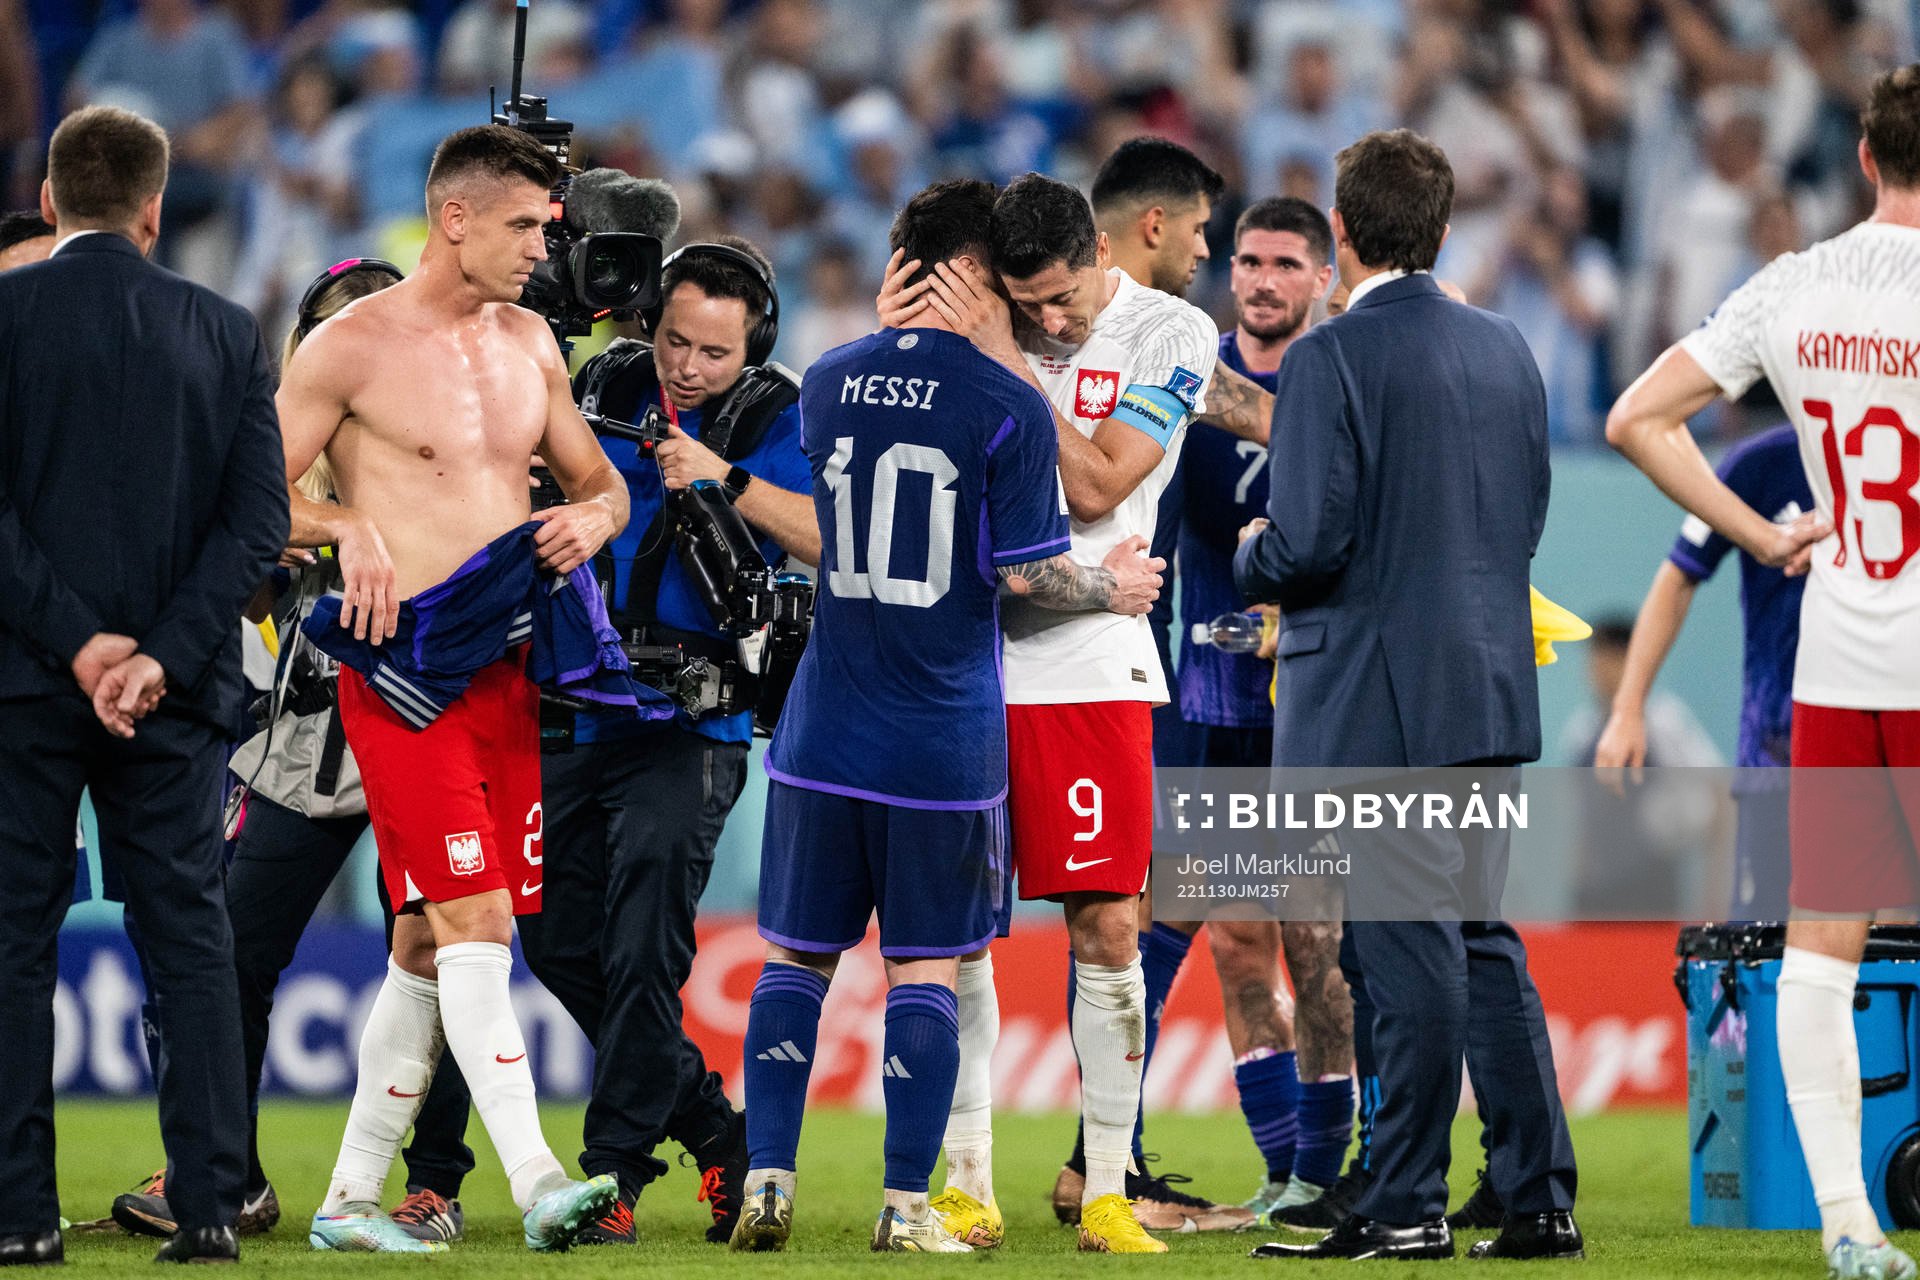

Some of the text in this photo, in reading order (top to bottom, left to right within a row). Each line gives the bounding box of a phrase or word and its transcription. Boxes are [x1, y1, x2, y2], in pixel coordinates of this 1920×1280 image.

[841, 374, 940, 411] MESSI
[1235, 440, 1268, 504] 7
[1802, 398, 1920, 580] 13
[708, 522, 726, 552] PRO
[822, 436, 959, 608] 10
[1068, 778, 1102, 841] 9
